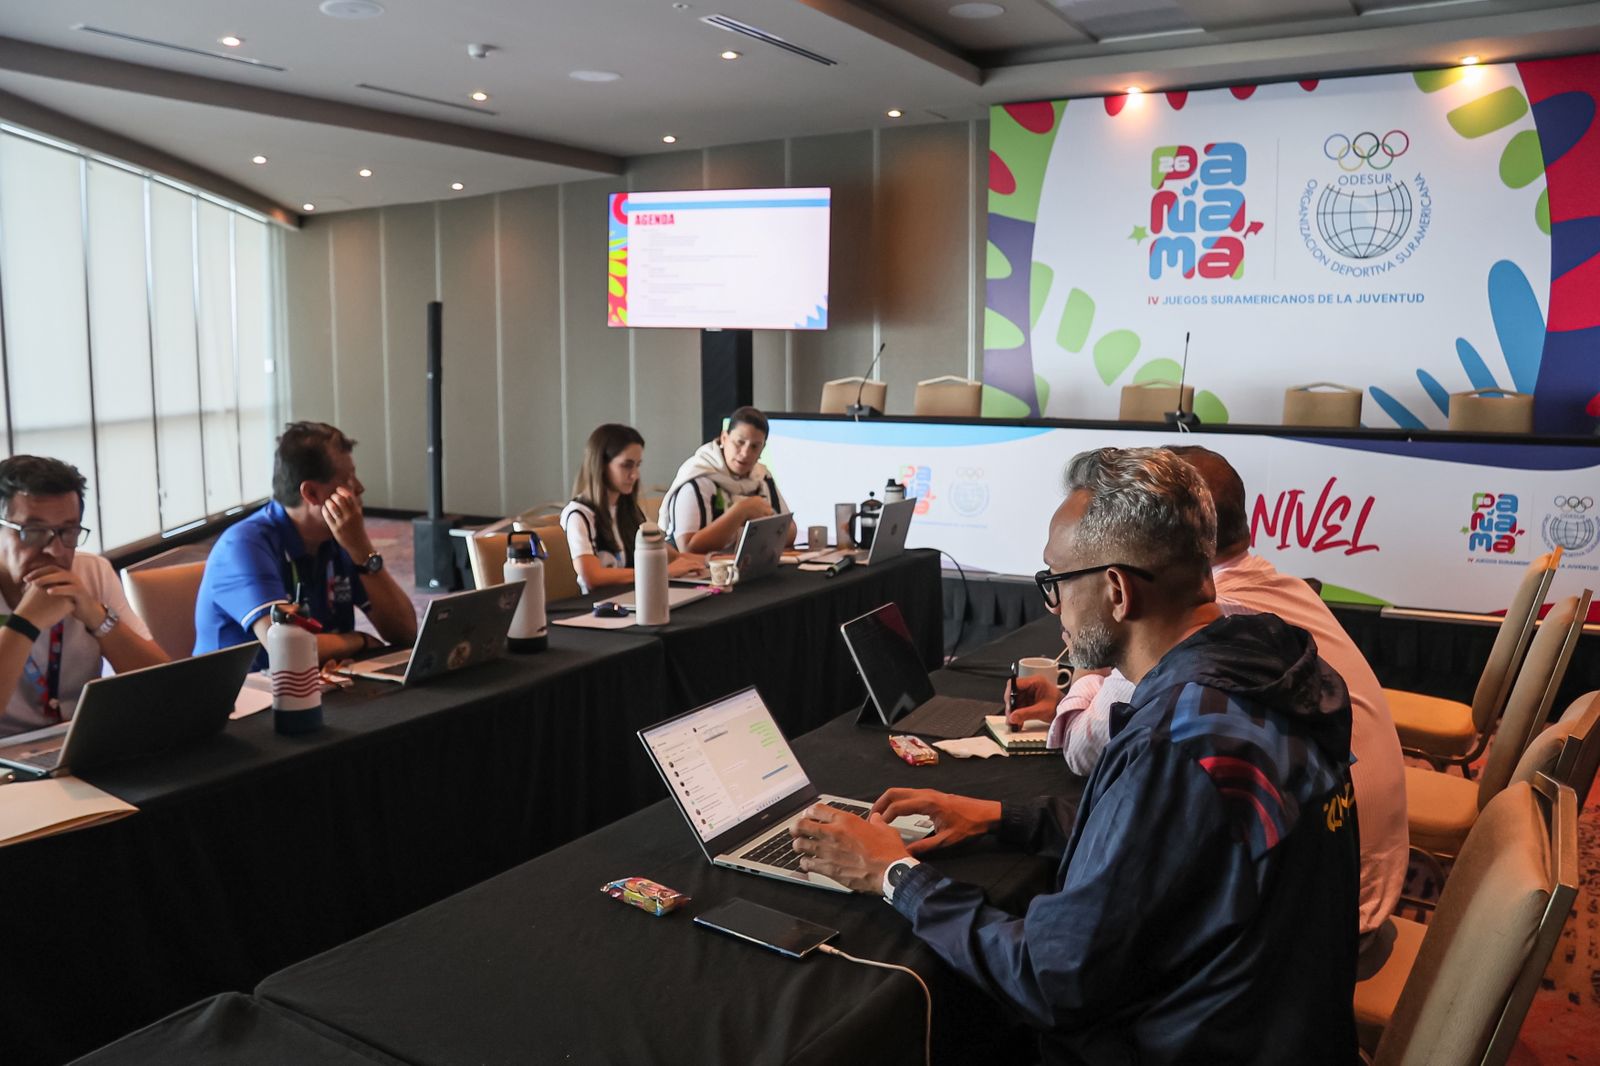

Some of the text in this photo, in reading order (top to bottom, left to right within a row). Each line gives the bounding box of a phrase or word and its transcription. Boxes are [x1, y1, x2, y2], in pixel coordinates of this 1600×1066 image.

[1338, 173, 1393, 186] ODESUR
[635, 213, 675, 225] AGENDA
[1330, 260, 1396, 278] DEPORTIVA
[1395, 172, 1432, 264] SURAMERICANA
[1147, 293, 1425, 305] IV JUEGOS SURAMERICANOS DE LA JUVENTUD
[1250, 476, 1380, 556] NIVEL
